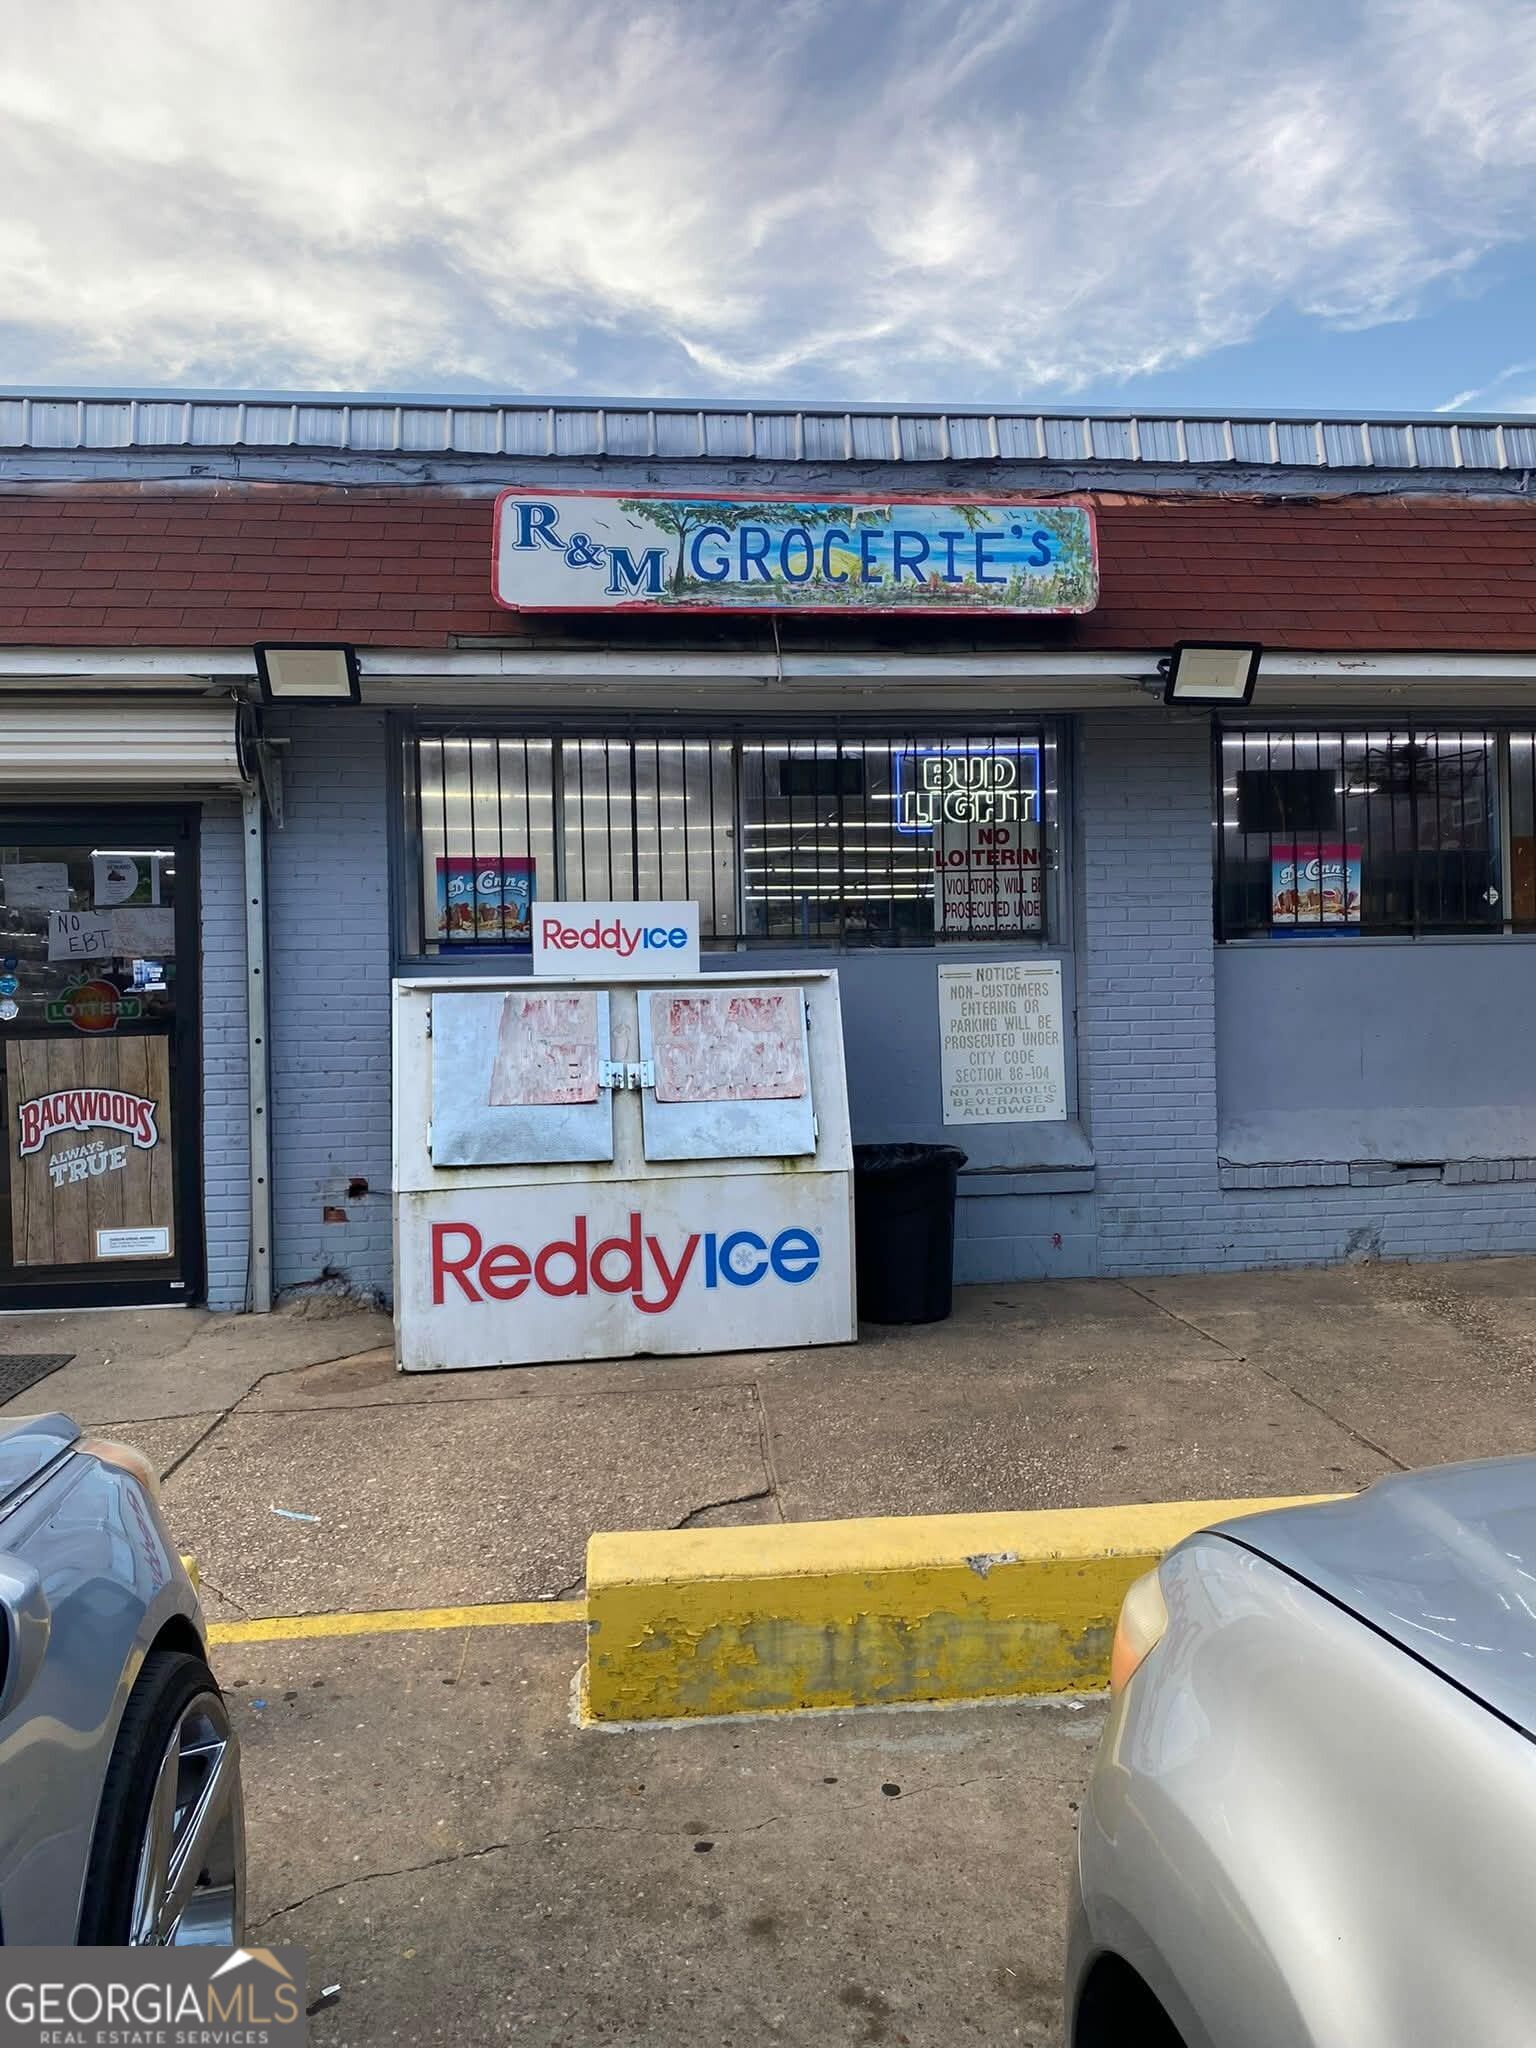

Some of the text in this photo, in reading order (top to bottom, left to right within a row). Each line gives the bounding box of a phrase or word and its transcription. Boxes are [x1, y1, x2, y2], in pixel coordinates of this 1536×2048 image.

[690, 525, 1052, 584] GROCERIE'S
[923, 756, 1016, 790] BUD
[905, 790, 1037, 823] LIGHT
[978, 829, 1010, 845] NO
[946, 878, 999, 895] VIOLATORS
[1004, 877, 1027, 894] WILL
[944, 900, 1041, 918] PROSECUTED UNDE
[58, 914, 80, 933] NO
[68, 929, 112, 952] EBT
[976, 967, 1021, 981] NOTICE
[950, 982, 1049, 1000] NON-CUSTOMERS
[52, 1001, 136, 1017] LOTTERY
[961, 999, 1040, 1016] ENTERING OR
[951, 1015, 1052, 1033] PARKING WILL BE
[944, 1031, 1059, 1050] PROSECUTED UNDER
[969, 1050, 1035, 1065] CITY CODE
[956, 1067, 1002, 1083] SECTION
[950, 1084, 1057, 1097] NO ALCOHOLIC
[953, 1095, 1055, 1107] BEVERAGES
[963, 1104, 1046, 1116] ALLOWED
[21, 1090, 155, 1152] BACKWOODS
[49, 1141, 104, 1166] ALWAYS
[50, 1145, 127, 1187] TRUE
